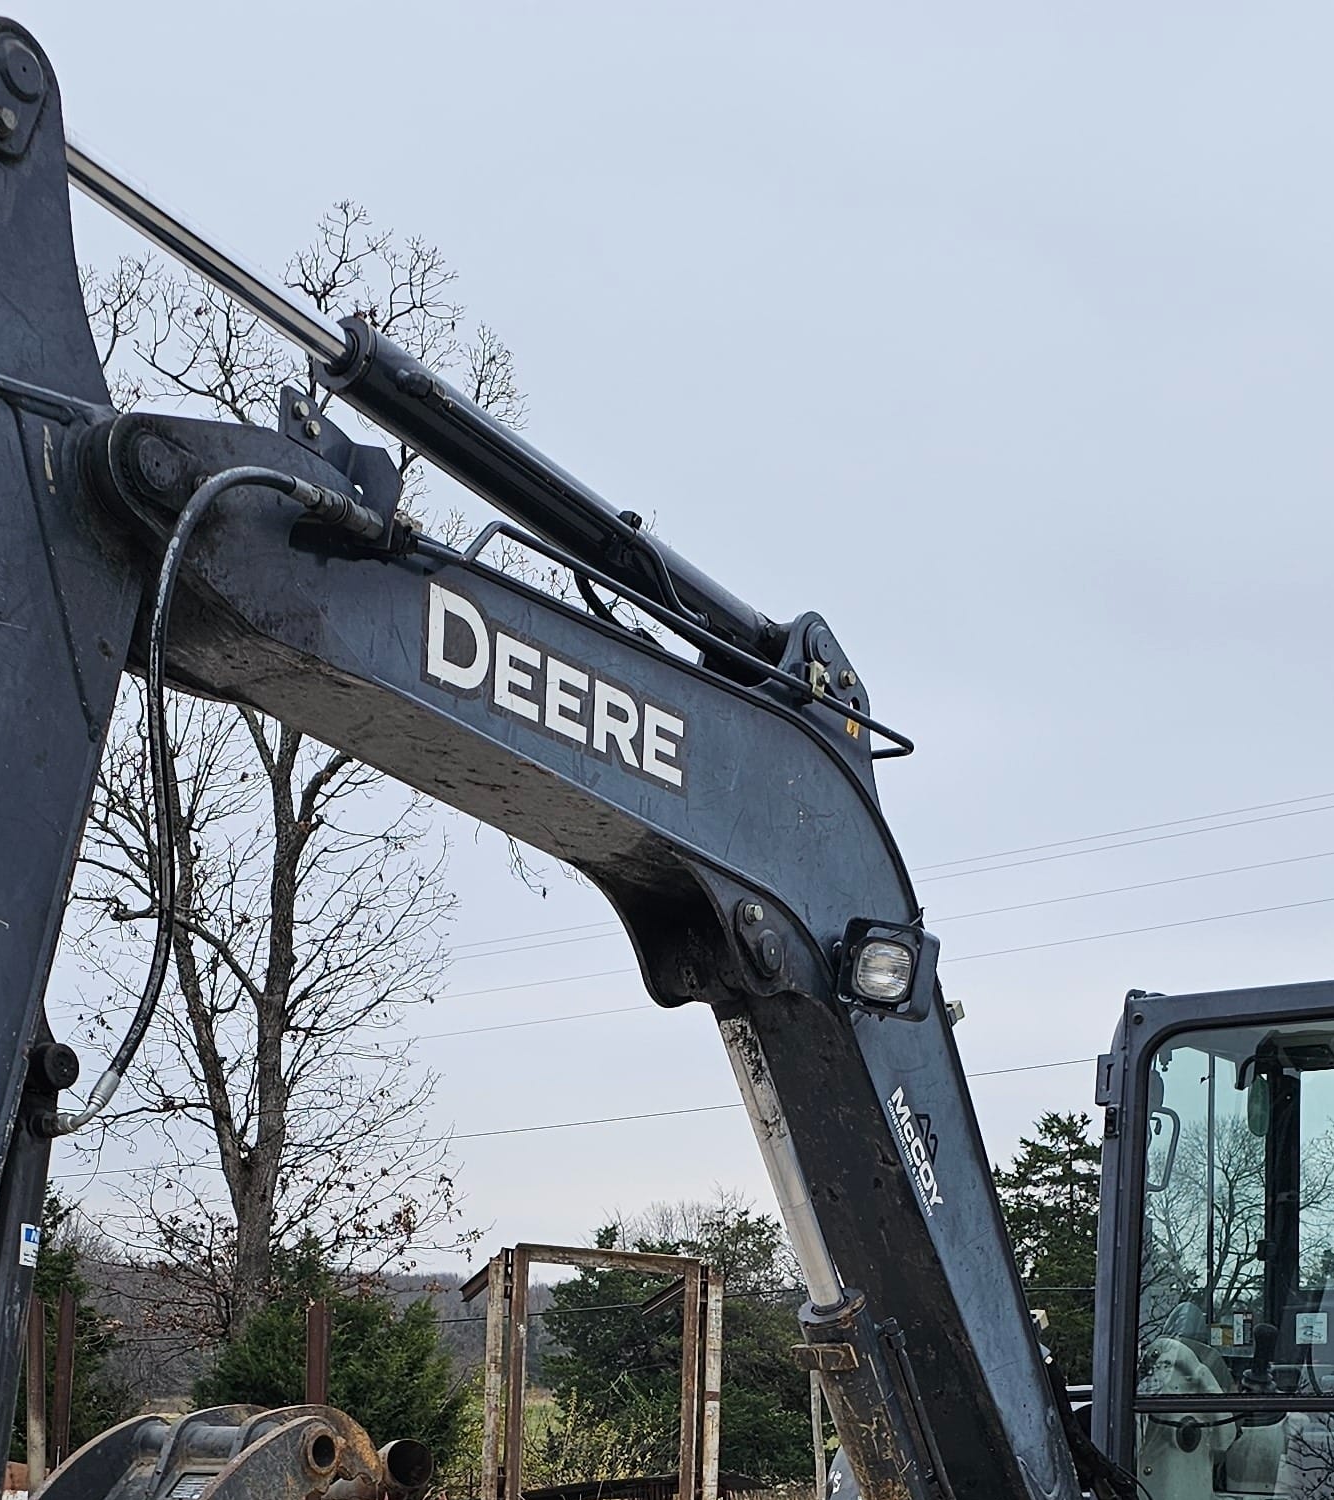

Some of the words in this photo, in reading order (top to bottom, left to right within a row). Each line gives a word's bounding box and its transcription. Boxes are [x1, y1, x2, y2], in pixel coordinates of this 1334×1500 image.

[427, 582, 684, 787] DEERE
[886, 1099, 914, 1166] CONSTRUCTION
[914, 1175, 934, 1217] FORESTRY
[891, 1086, 944, 1206] McCOY
